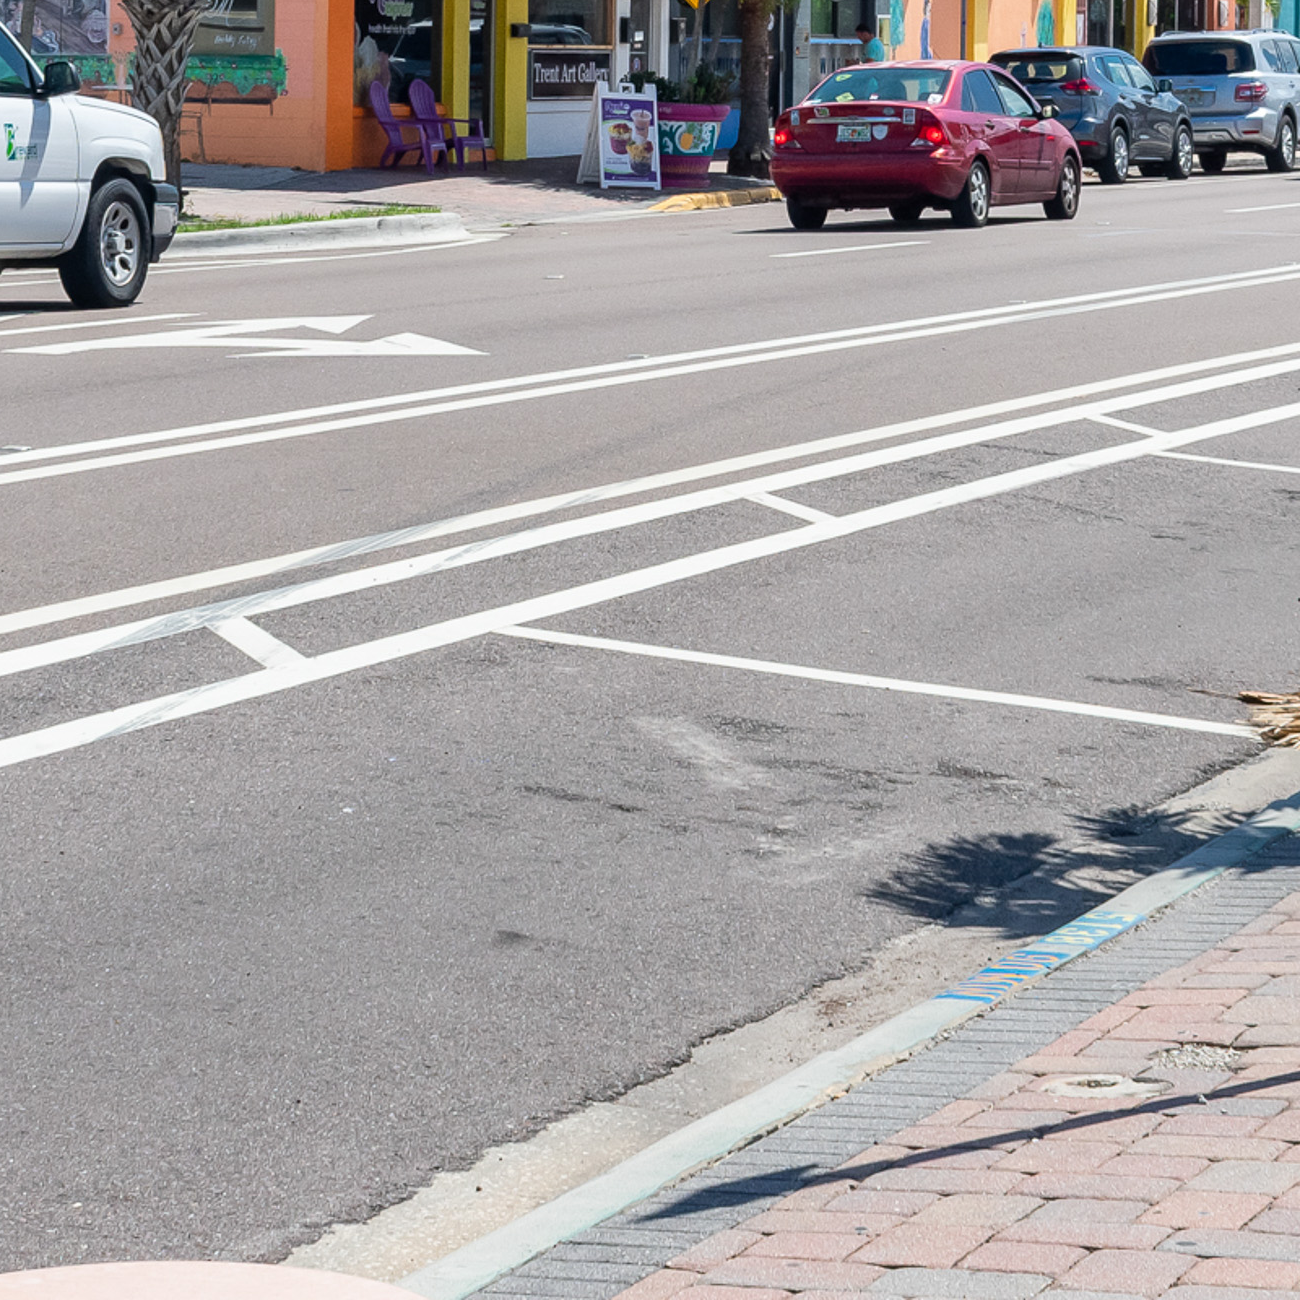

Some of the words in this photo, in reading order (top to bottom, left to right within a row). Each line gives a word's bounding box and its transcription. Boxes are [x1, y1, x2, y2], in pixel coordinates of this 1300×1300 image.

[534, 63, 559, 83] Trent
[561, 64, 576, 83] Art
[578, 62, 610, 82] Gallery
